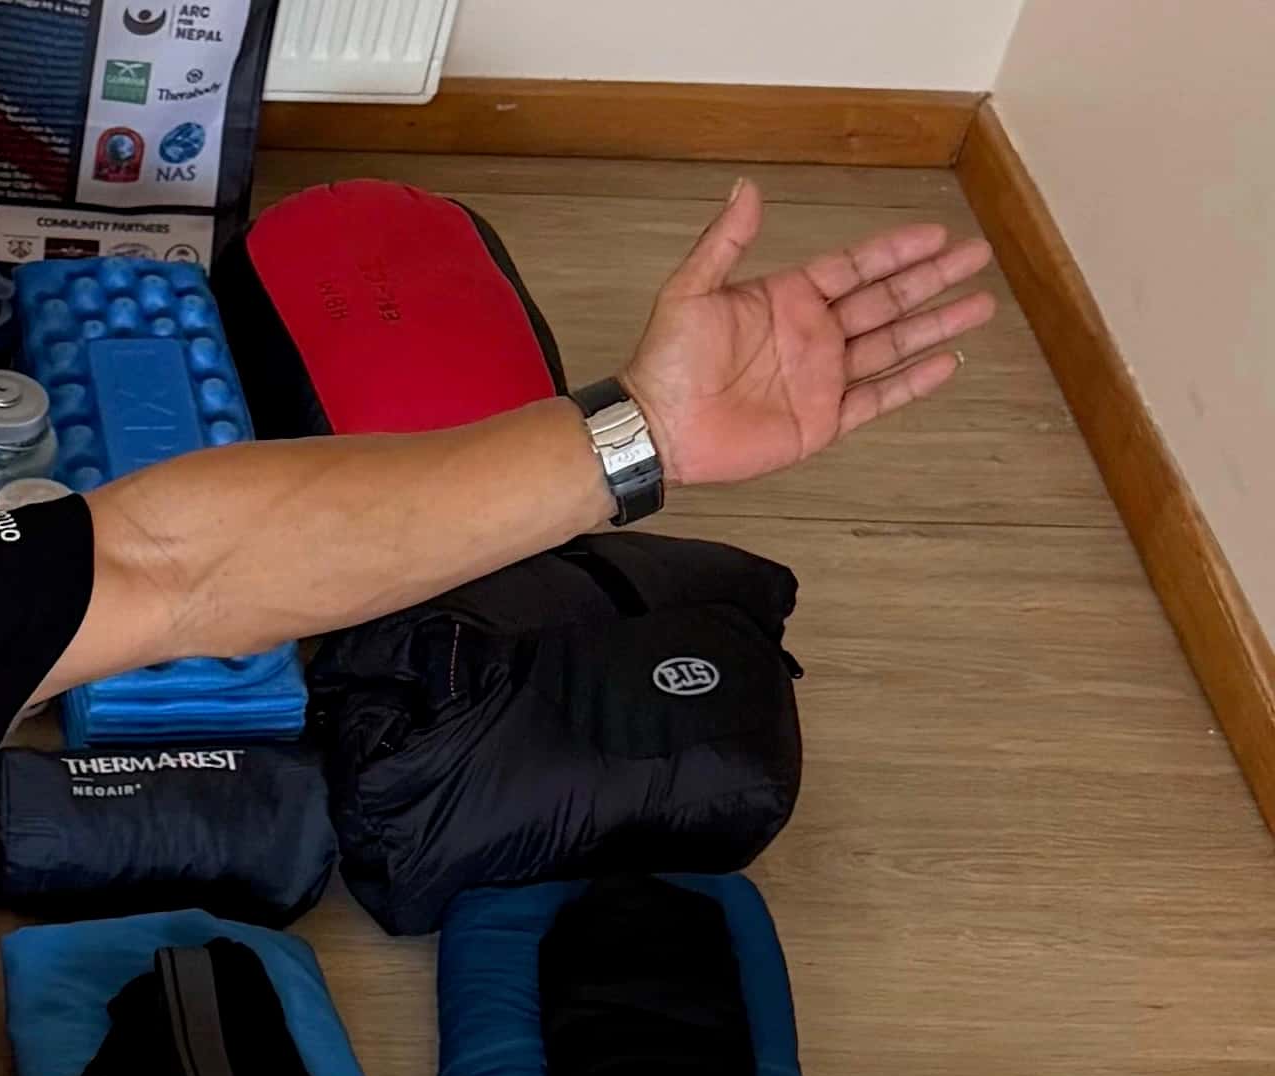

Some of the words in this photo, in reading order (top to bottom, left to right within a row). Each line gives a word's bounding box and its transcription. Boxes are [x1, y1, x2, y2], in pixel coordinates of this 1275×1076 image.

[179, 5, 211, 18] ARC
[175, 28, 223, 42] NEPAL
[155, 165, 197, 183] NAS
[72, 784, 139, 797] NEOAIR
